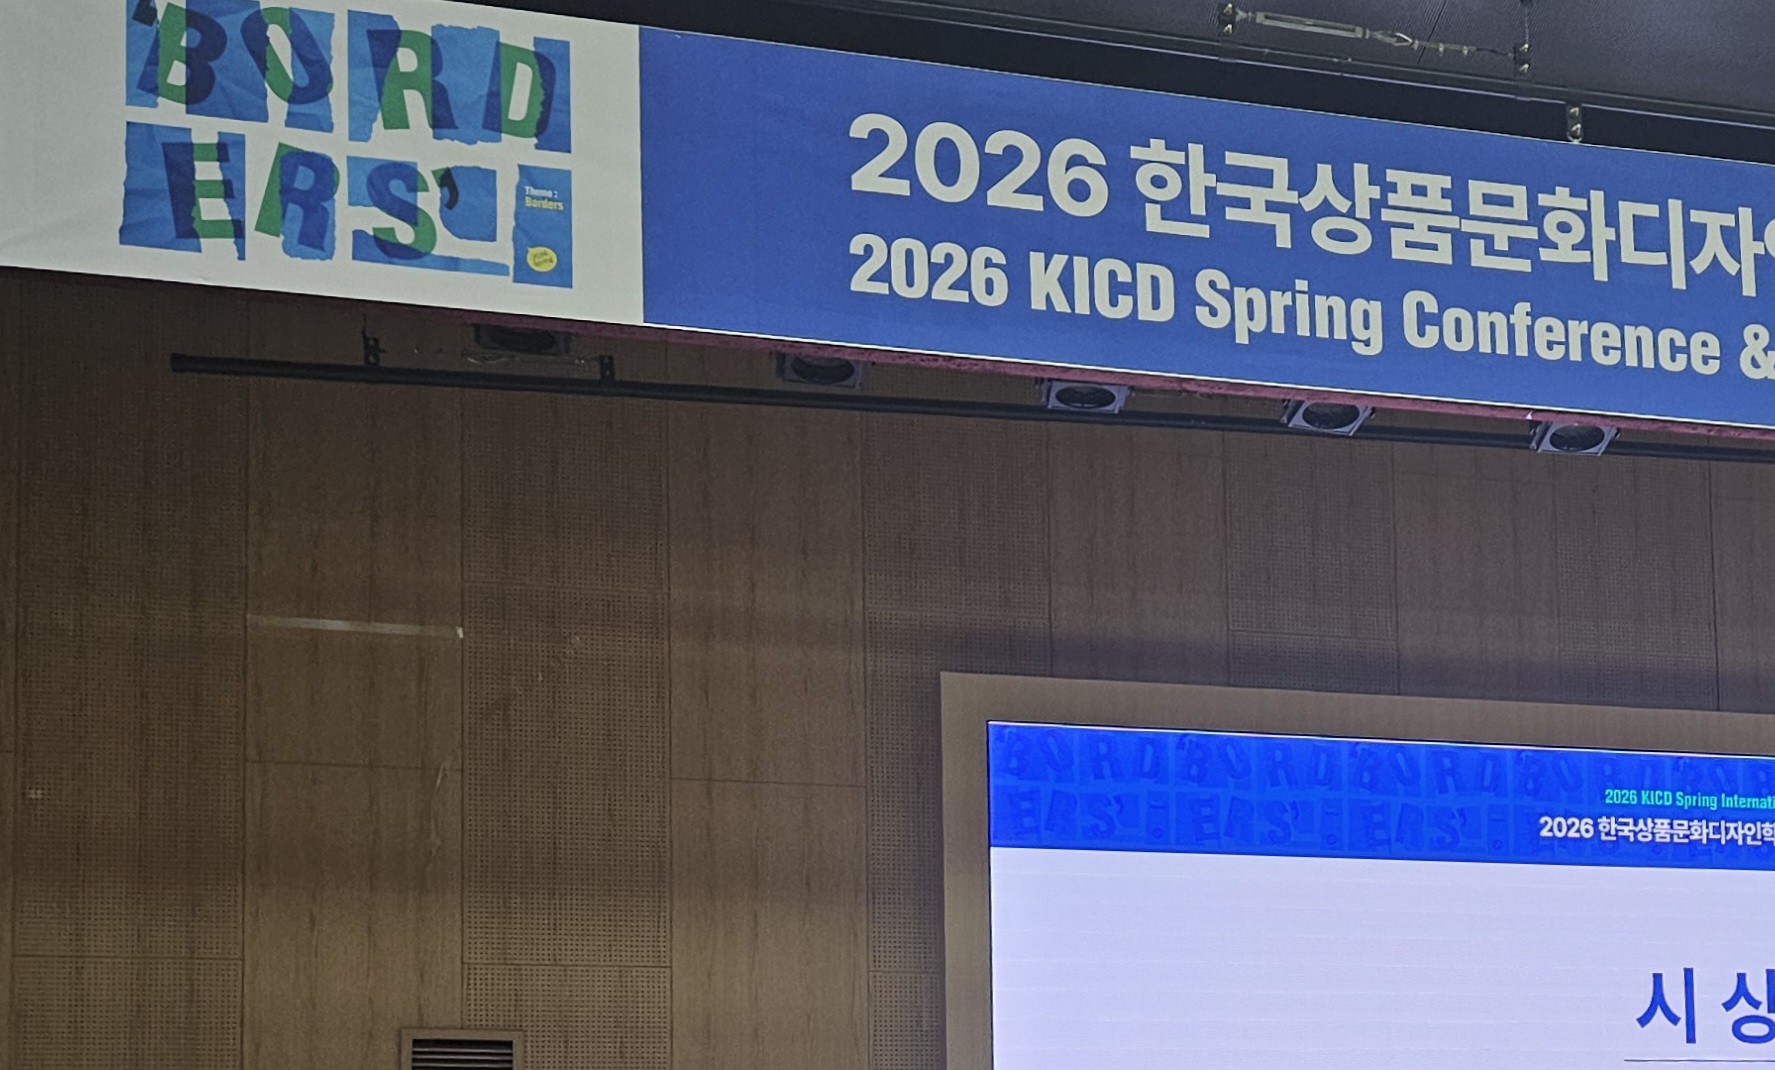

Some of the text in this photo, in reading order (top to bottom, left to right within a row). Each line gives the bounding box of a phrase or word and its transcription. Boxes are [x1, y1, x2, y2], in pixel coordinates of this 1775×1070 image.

[850, 114, 1109, 217] 2026
[849, 233, 1009, 307] 2026
[1029, 251, 1175, 322] KICD
[1195, 268, 1383, 356] Spring
[1402, 290, 1721, 376] Conference
[1539, 815, 1595, 839] 2026
[1605, 788, 1637, 805] 2026
[1641, 790, 1673, 806] KICD
[1676, 791, 1718, 811] Spring
